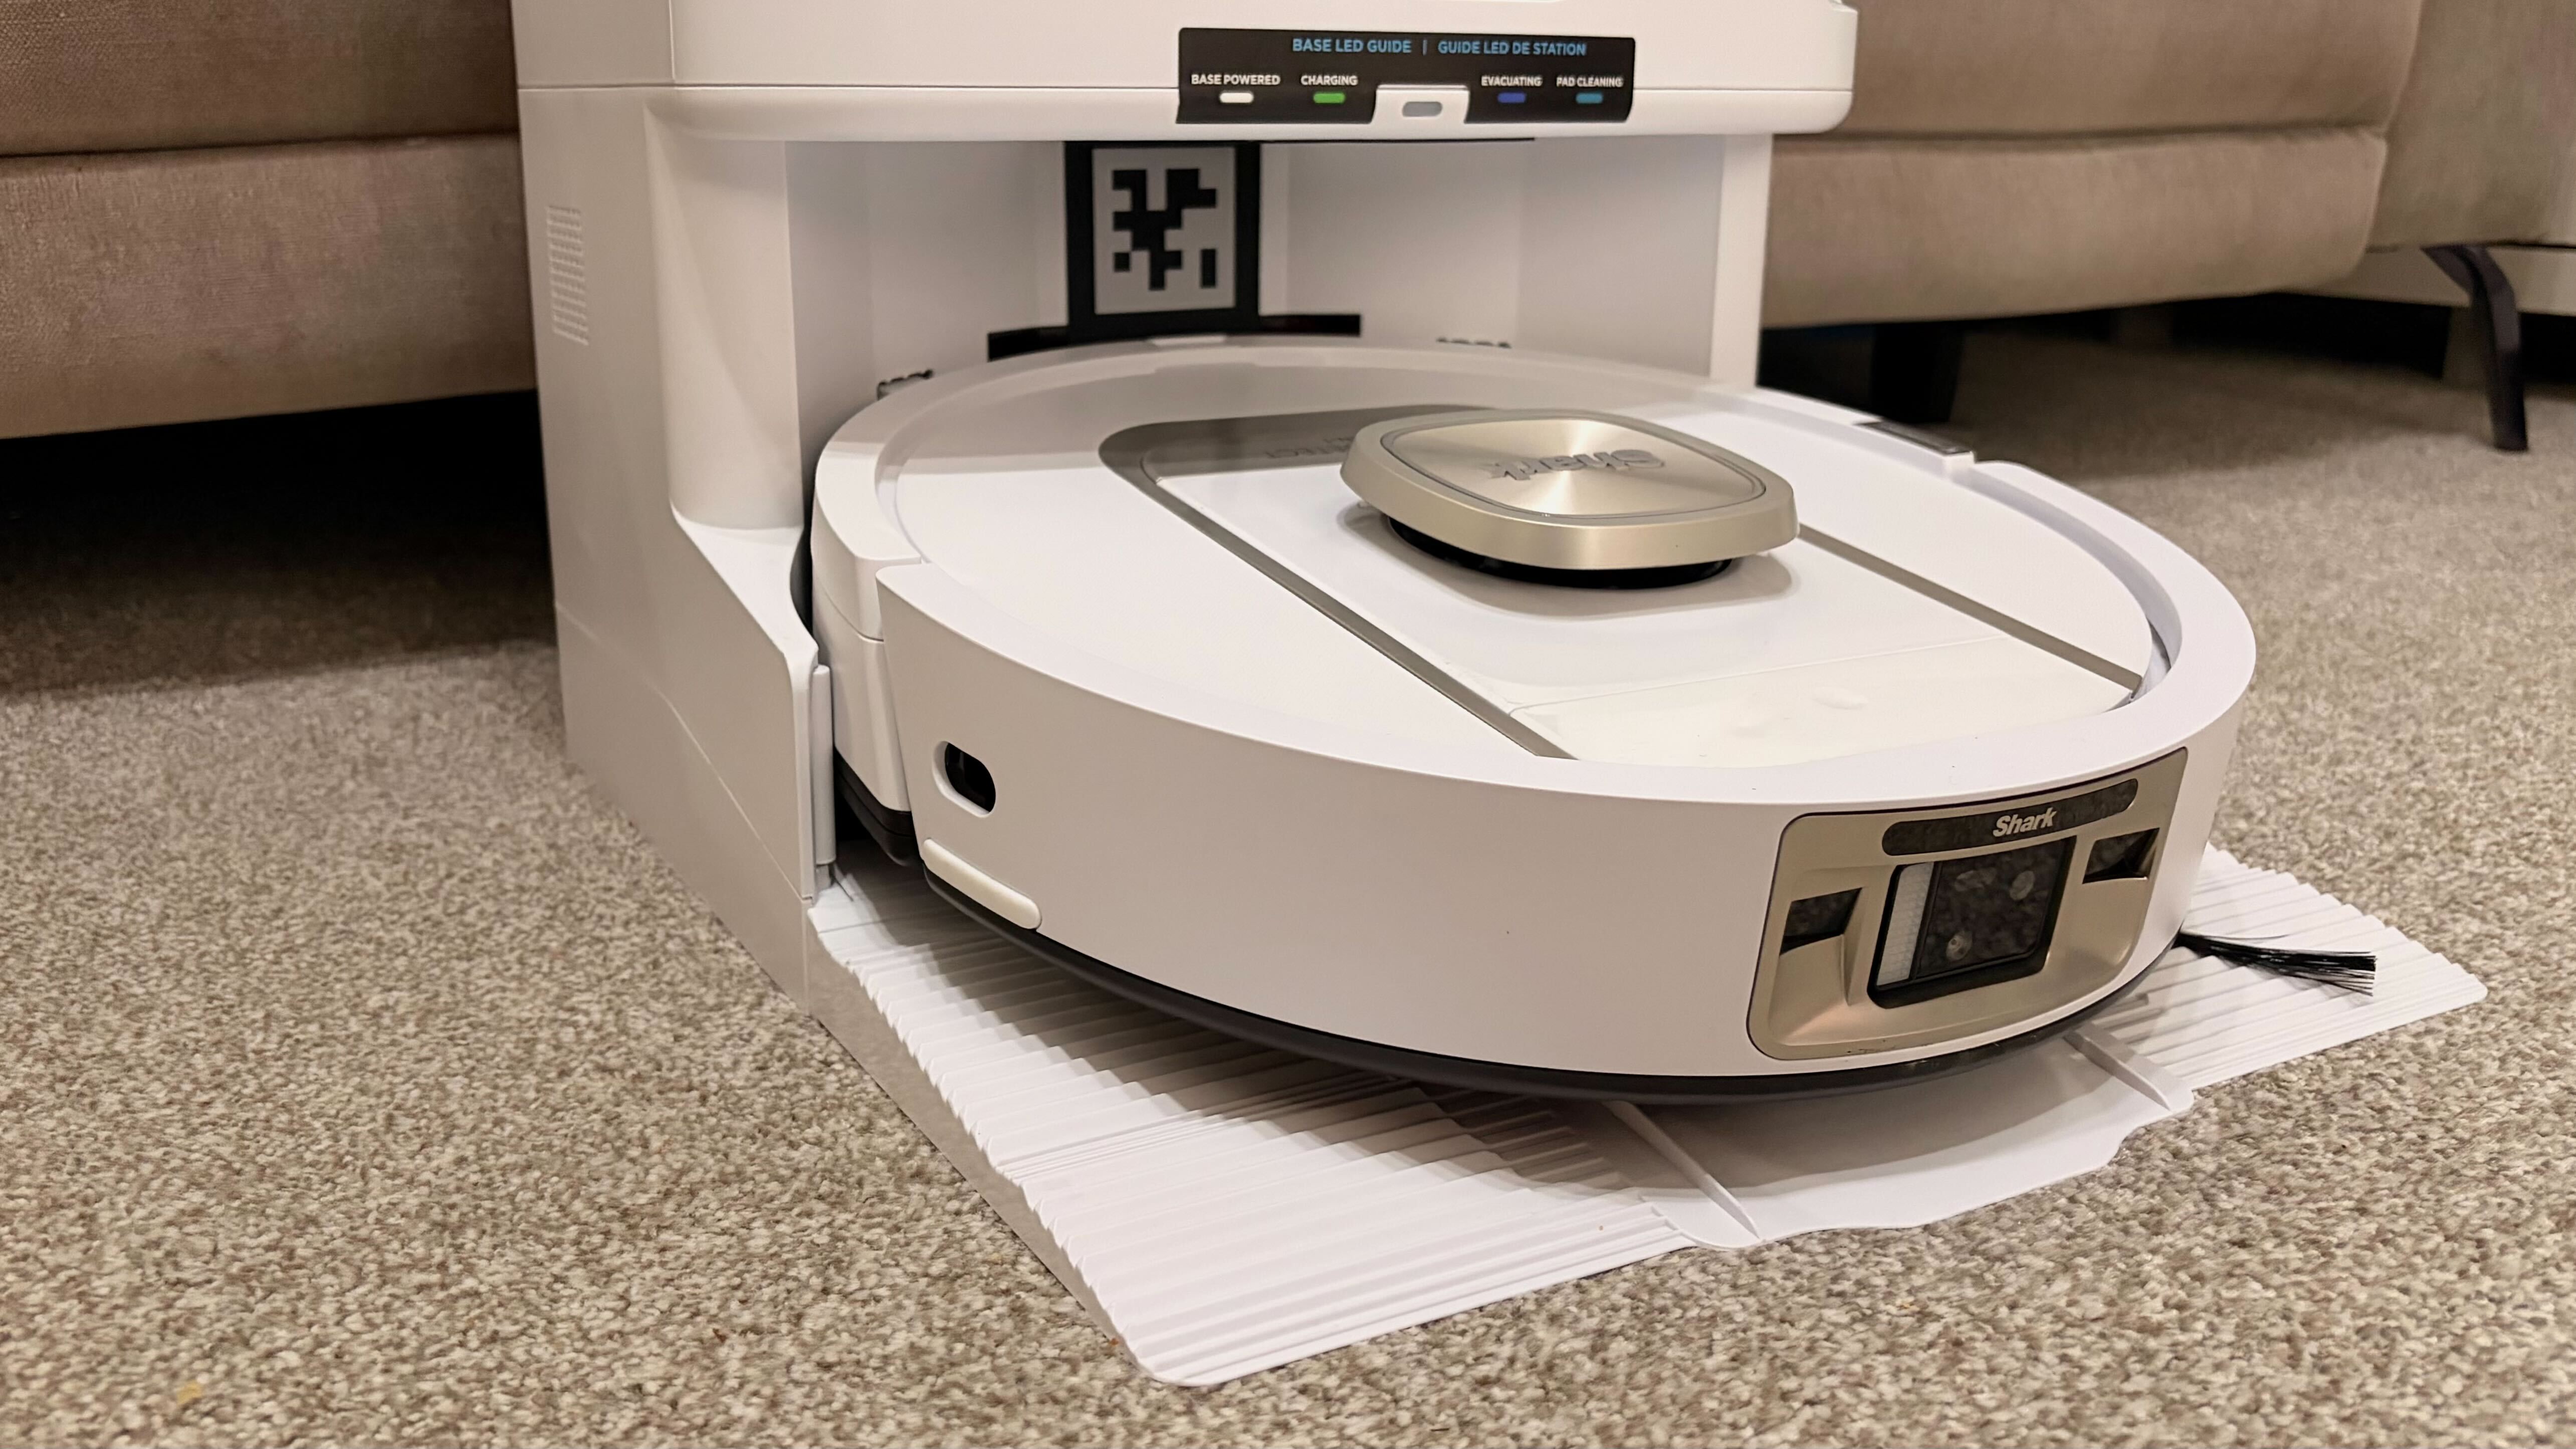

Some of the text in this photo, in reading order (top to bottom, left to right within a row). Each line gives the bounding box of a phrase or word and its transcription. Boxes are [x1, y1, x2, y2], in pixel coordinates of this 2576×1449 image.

[1292, 39, 1412, 53] BASE LED GUIDE
[1437, 41, 1587, 56] GUIDE LED DE STATION
[1191, 74, 1281, 85] BASE POWERED
[1301, 75, 1358, 86] CHARGING
[1481, 75, 1543, 87] EVACUATING
[1556, 76, 1624, 88] PAD CLEANING
[1482, 450, 1664, 480] Shark
[1993, 807, 2057, 837] Shark
